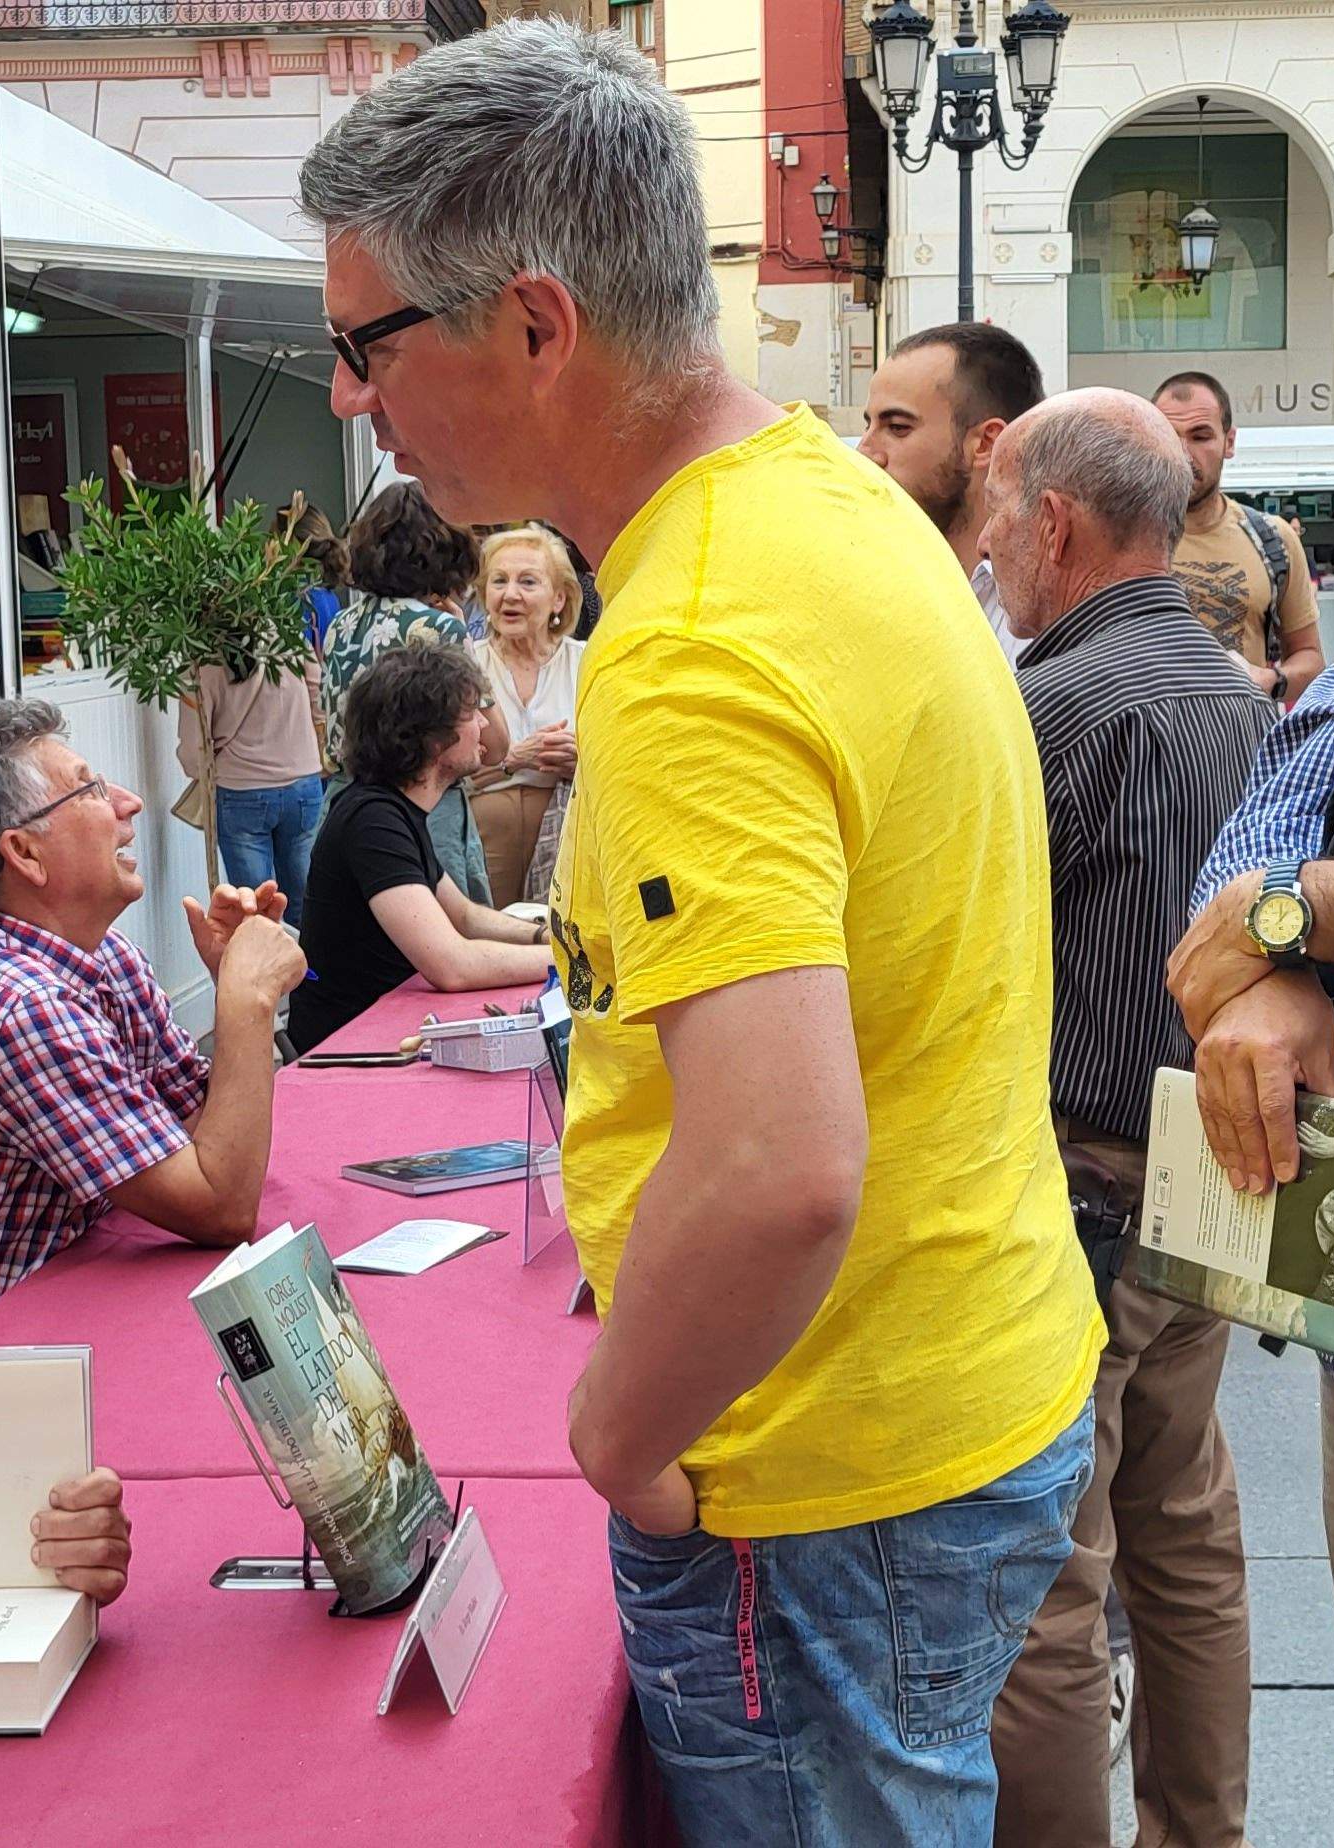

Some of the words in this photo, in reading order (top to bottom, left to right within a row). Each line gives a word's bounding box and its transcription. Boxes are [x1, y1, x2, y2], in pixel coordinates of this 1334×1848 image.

[264, 1274, 298, 1312] JORGE
[274, 1291, 312, 1332] MOLIST
[284, 1327, 311, 1361] EL
[299, 1331, 354, 1393] LATIDO
[262, 1388, 280, 1416] MAR
[314, 1382, 350, 1423] DEL
[277, 1414, 292, 1438] DEL
[332, 1406, 370, 1454] MAR
[739, 1567, 754, 1624] WORLD
[740, 1626, 752, 1660] THE
[743, 1664, 758, 1708] LOVE
